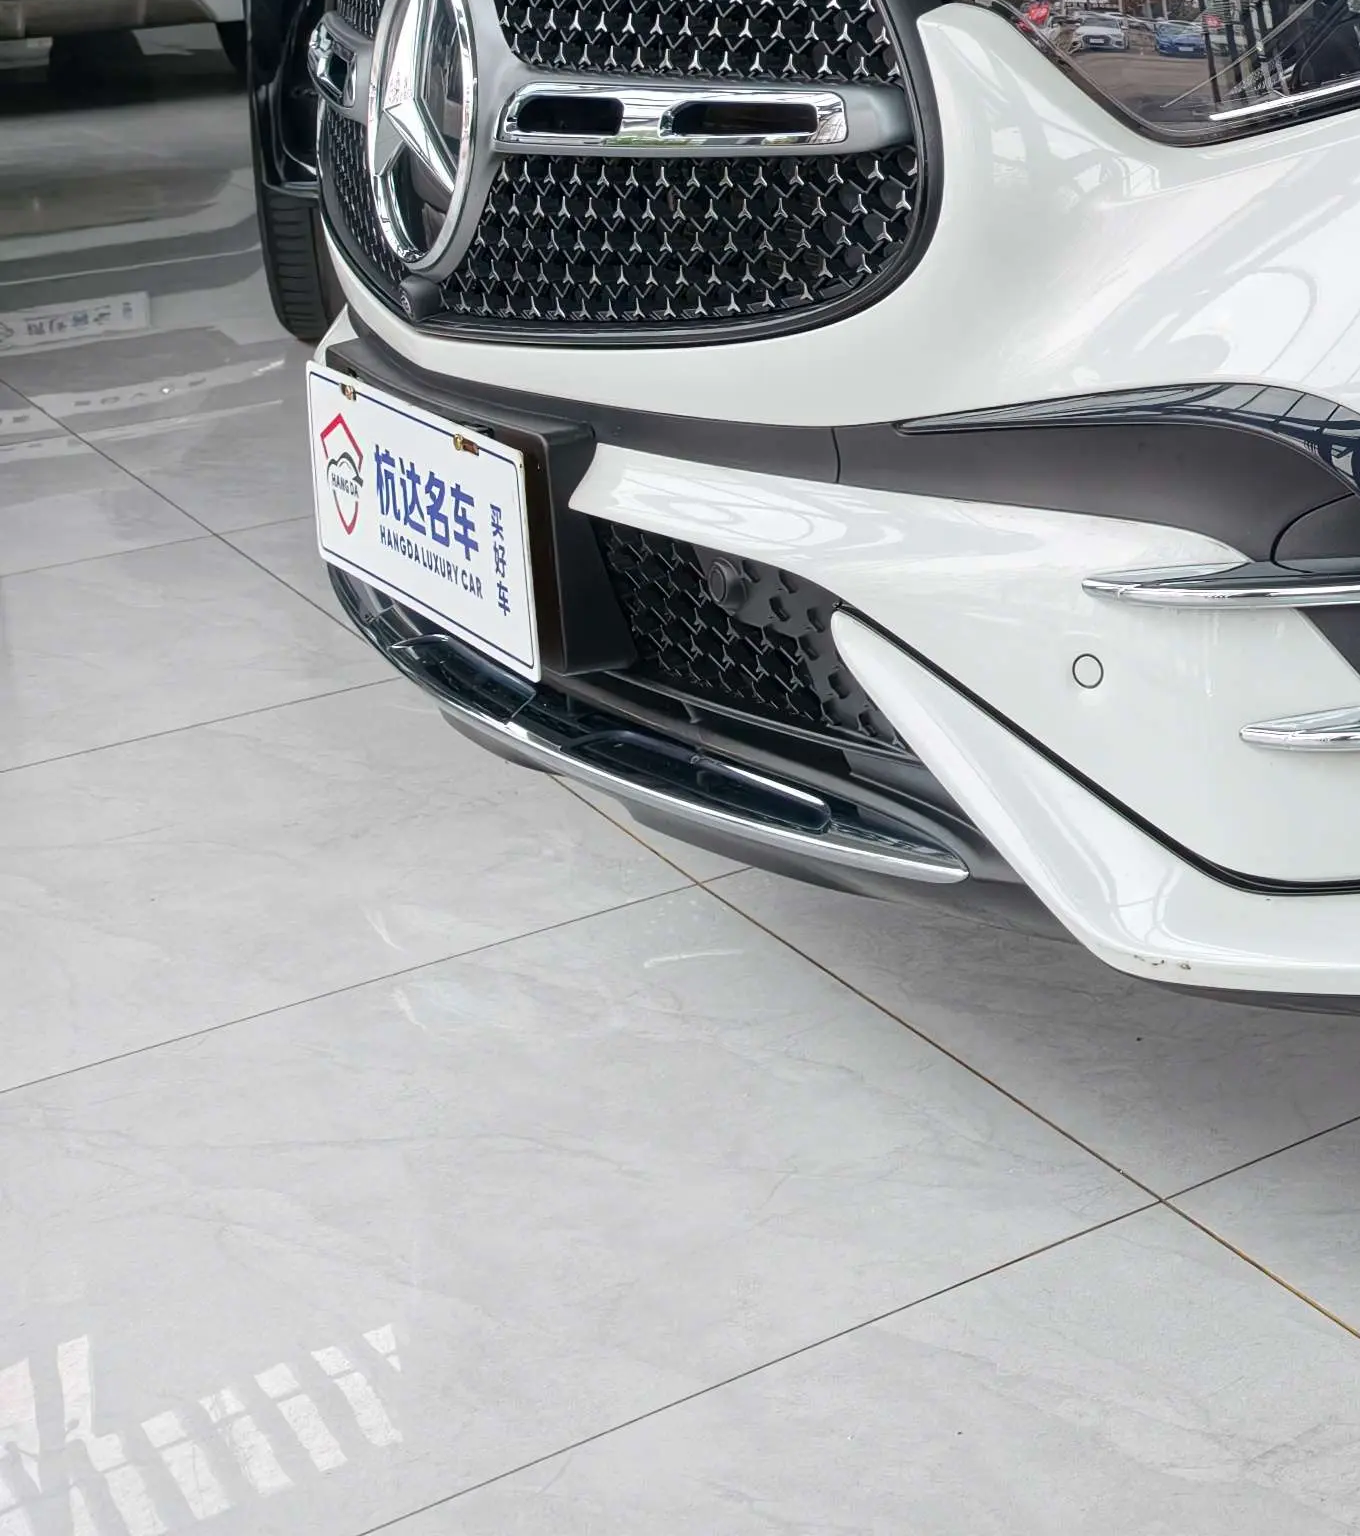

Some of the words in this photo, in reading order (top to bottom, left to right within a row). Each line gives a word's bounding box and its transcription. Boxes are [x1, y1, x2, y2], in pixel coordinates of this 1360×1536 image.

[331, 472, 349, 494] HANG
[349, 481, 360, 499] DA
[374, 443, 480, 562] 杭达名车
[379, 524, 420, 564] HANGDA
[420, 549, 460, 587] LUXURY
[461, 572, 484, 600] CAR
[489, 502, 512, 617] 买好车
